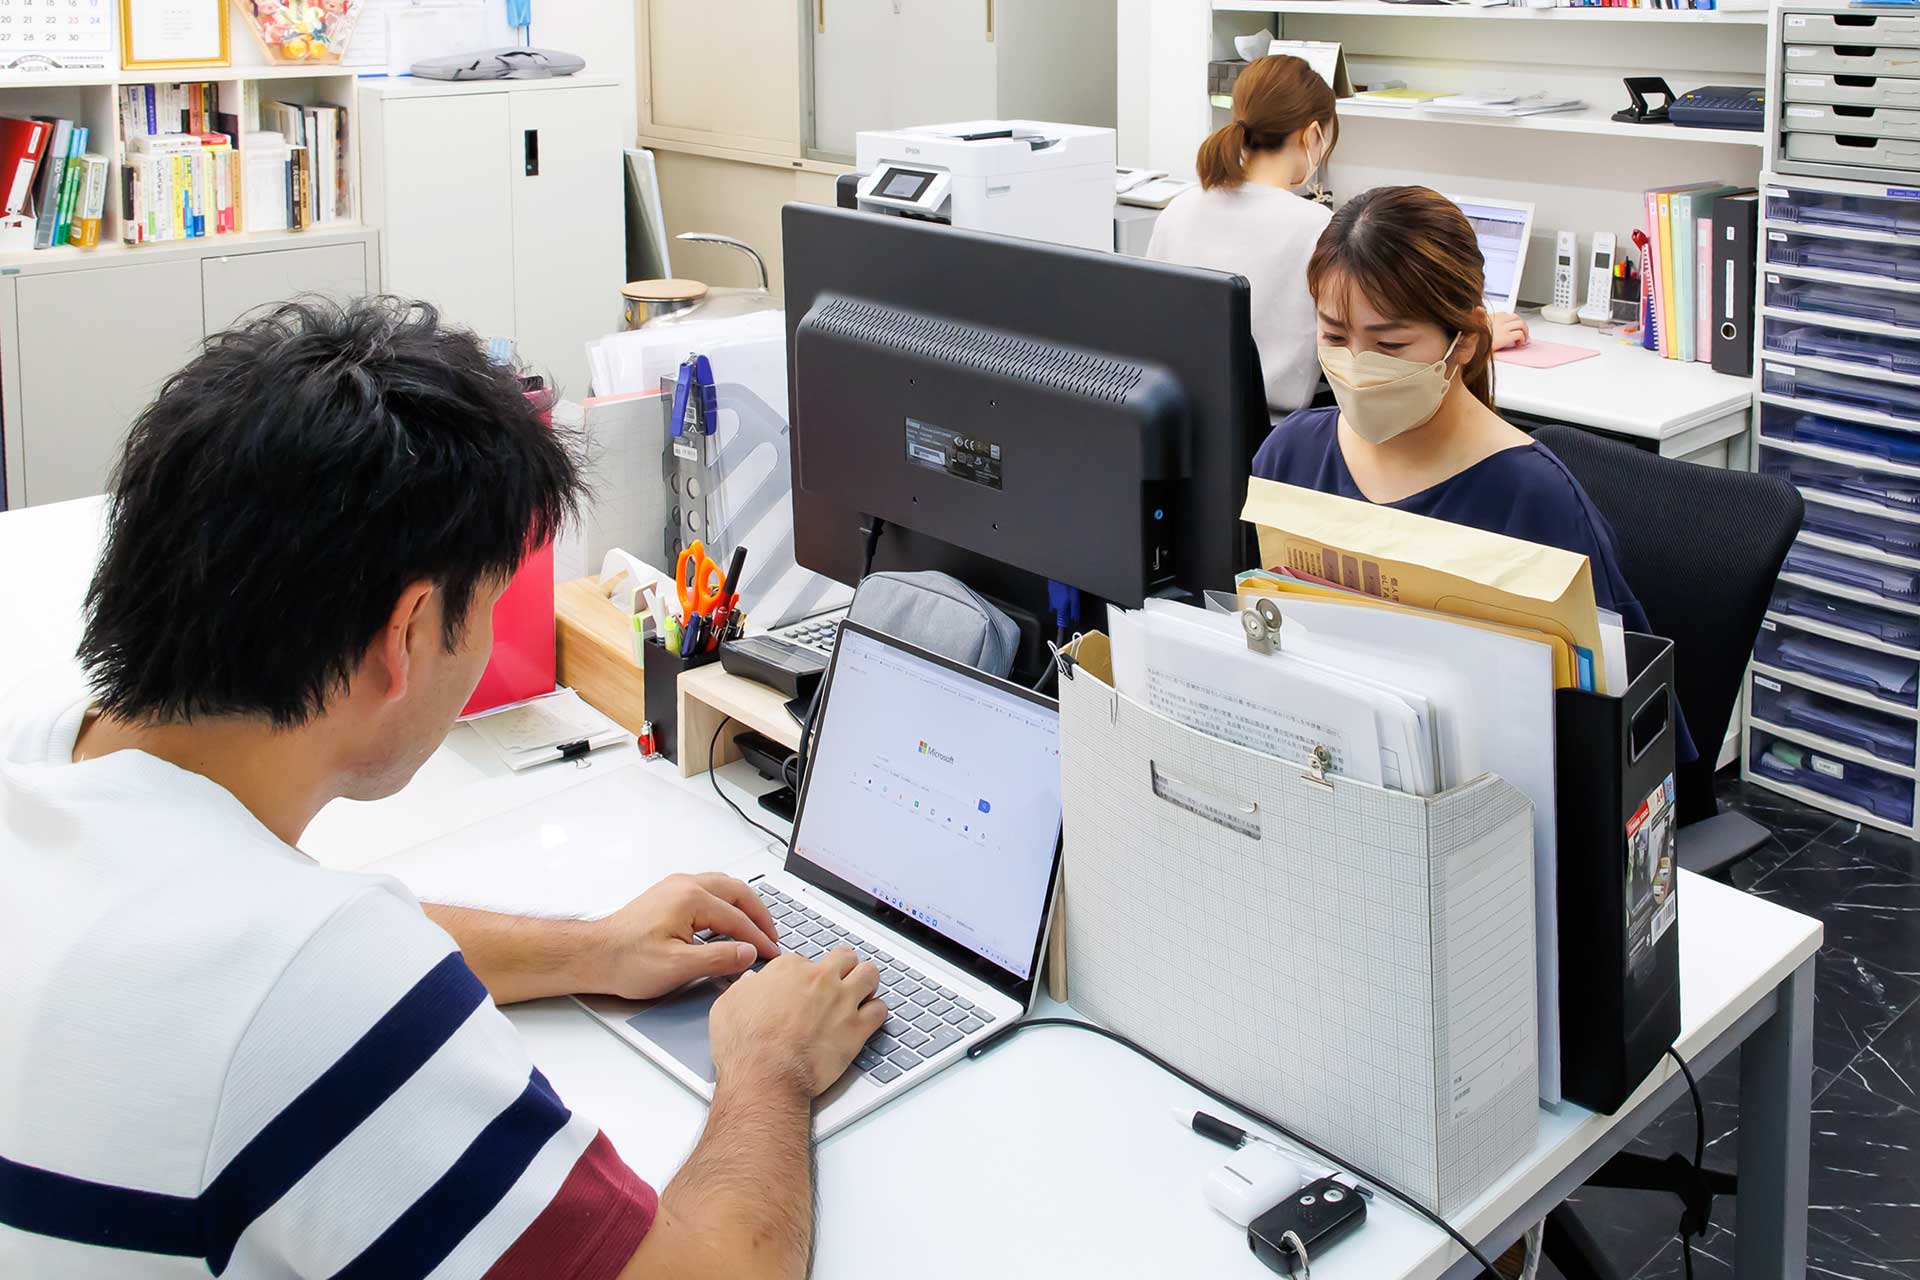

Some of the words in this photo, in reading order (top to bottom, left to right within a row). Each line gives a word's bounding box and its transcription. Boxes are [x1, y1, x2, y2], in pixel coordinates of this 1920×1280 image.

[0, 15, 12, 24] 20
[23, 16, 32, 24] 21
[45, 16, 57, 24] 22
[68, 16, 79, 24] 23
[90, 17, 101, 25] 24
[0, 33, 11, 41] 27
[23, 33, 34, 41] 28
[45, 33, 57, 41] 29
[928, 746, 955, 765] Microsoft
